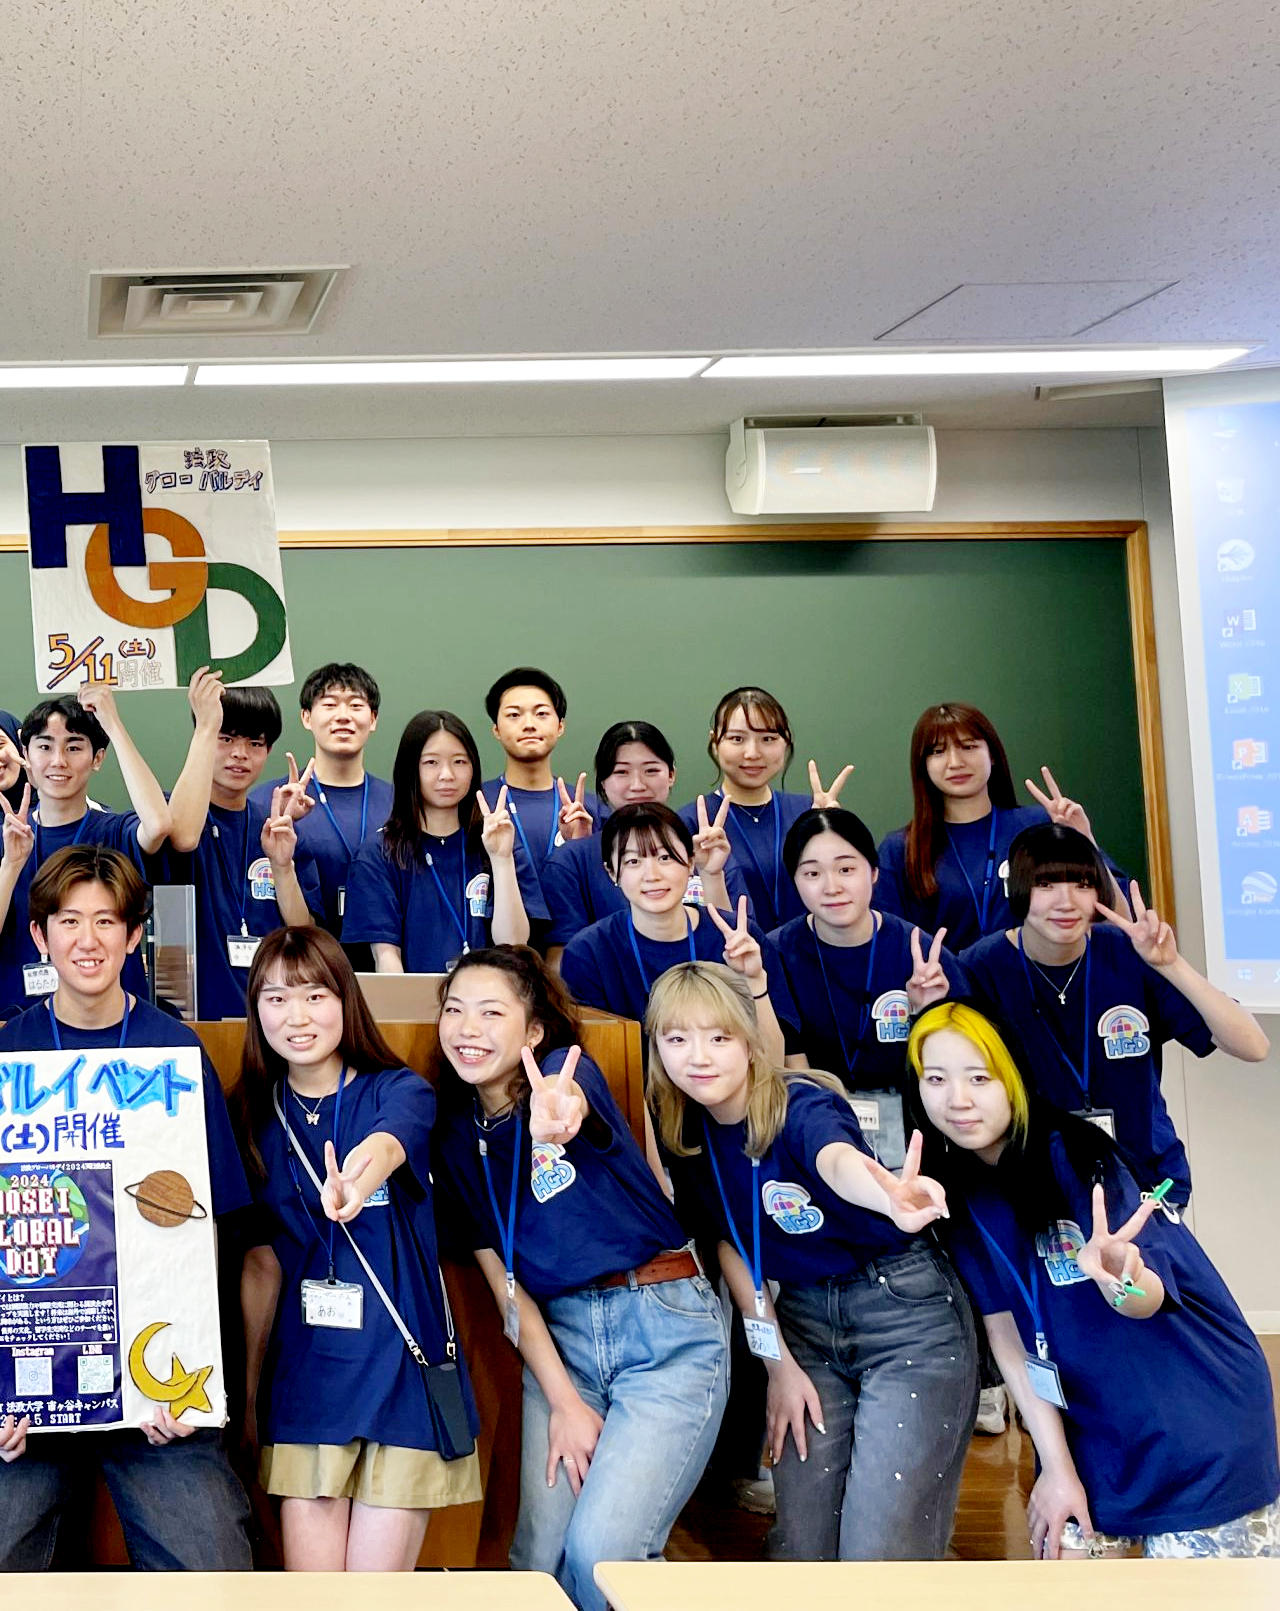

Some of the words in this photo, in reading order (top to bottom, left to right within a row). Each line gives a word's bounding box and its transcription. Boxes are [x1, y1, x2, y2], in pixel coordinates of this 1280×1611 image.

[25, 445, 286, 687] HGD
[253, 881, 277, 897] HG
[878, 1021, 909, 1040] HG
[1106, 1036, 1150, 1057] HGD
[10, 1174, 49, 1188] 2024
[533, 1165, 572, 1200] HGD
[774, 1207, 822, 1234] HGD
[6, 1247, 58, 1277] DAY
[1047, 1259, 1086, 1282] HG
[50, 1413, 82, 1424] START
